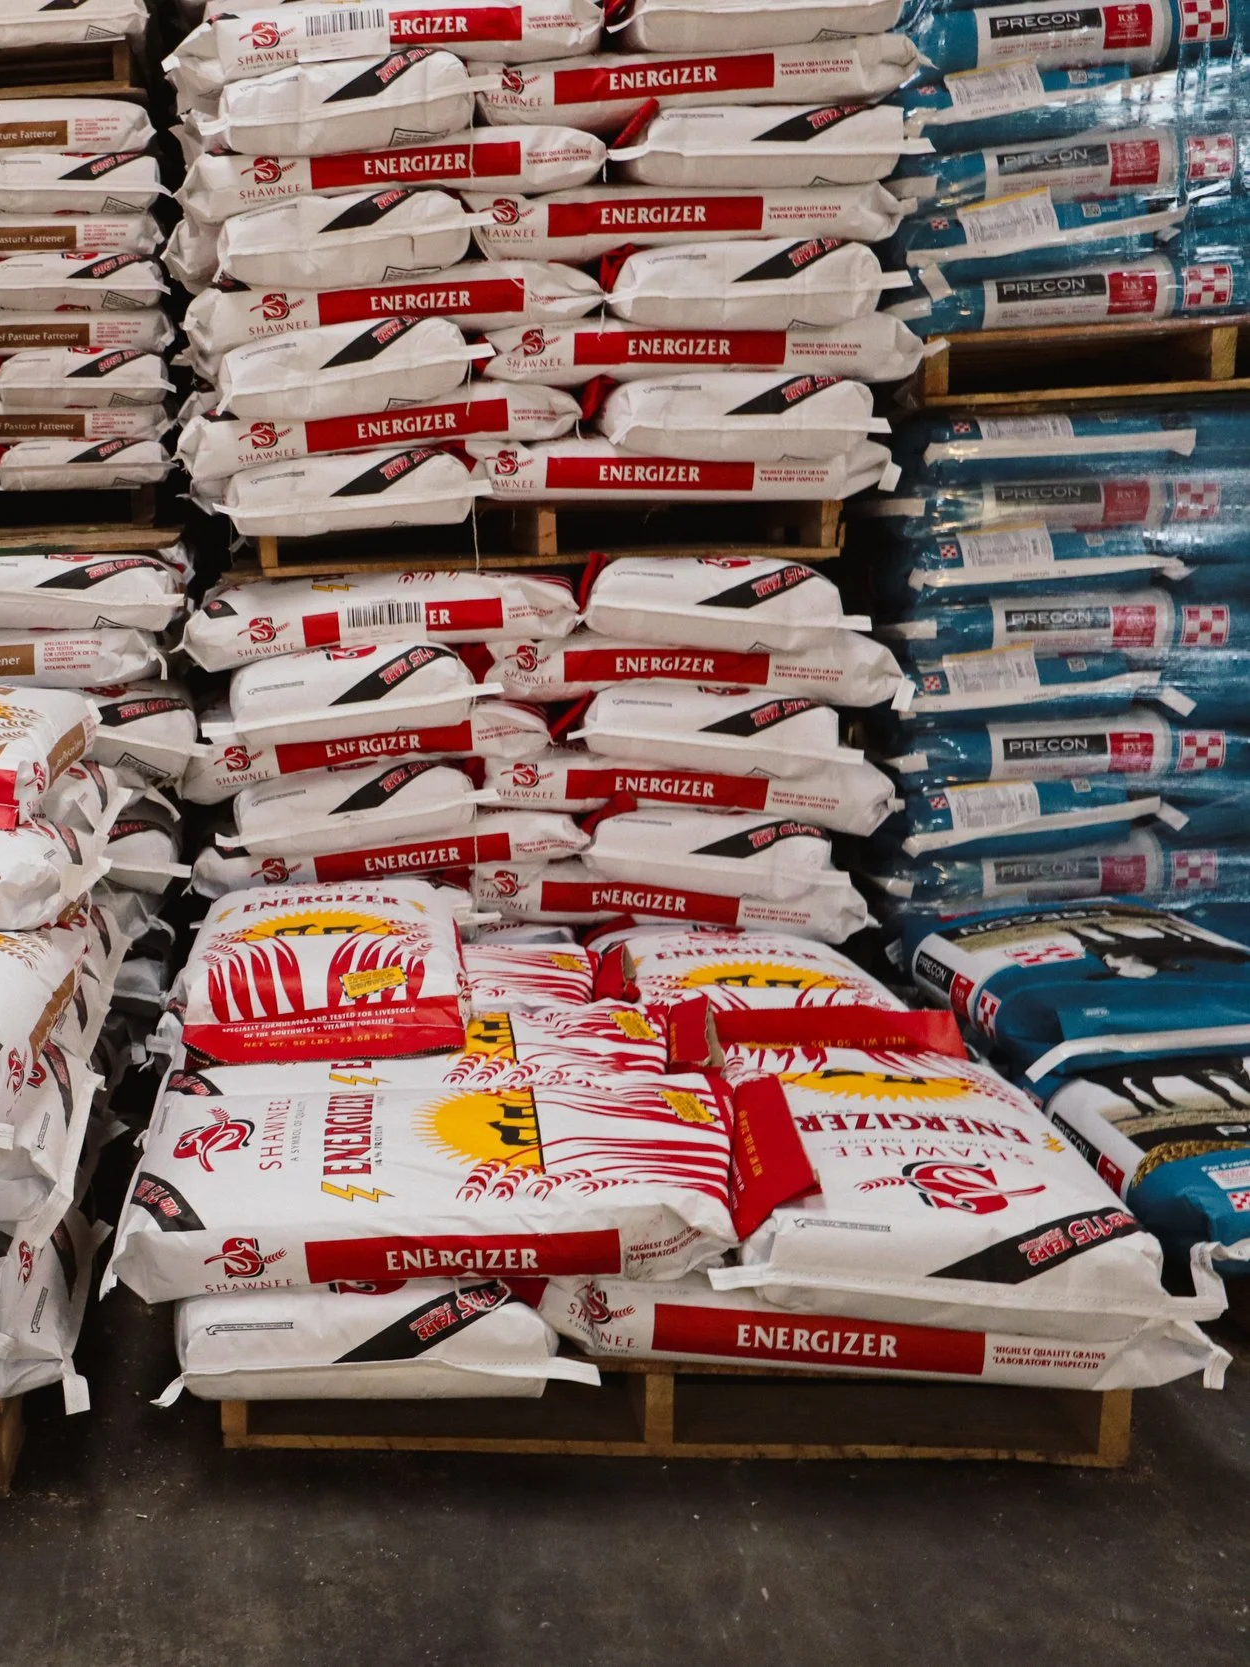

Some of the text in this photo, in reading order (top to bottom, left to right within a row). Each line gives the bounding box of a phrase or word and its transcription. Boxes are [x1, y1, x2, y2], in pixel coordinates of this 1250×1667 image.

[390, 16, 468, 35] ERGIZER
[996, 12, 1080, 30] PRECON
[237, 49, 298, 66] SHAWNEE
[609, 65, 717, 91] ENERGIZER
[20, 130, 57, 139] Fattener
[364, 153, 466, 175] ENERGIZER
[600, 205, 706, 225] ENERGIZER
[1002, 278, 1086, 296] PRECON
[370, 290, 471, 311] ENERGIZER
[8, 332, 41, 341] Pasture
[43, 332, 79, 340] Fattener
[248, 320, 309, 335] SHAWNEE
[628, 338, 730, 356] ENERGIZER
[357, 412, 457, 439] ENERGIZER
[1001, 486, 1081, 500] PRECON
[616, 657, 714, 673] ENERGIZER
[1009, 738, 1088, 753] PRECON
[615, 776, 714, 798] ENERGIZER
[364, 847, 460, 871] ENERGIZER
[243, 894, 398, 913] ENERGIZER
[592, 889, 686, 912] ENERGIZER
[918, 956, 947, 982] PRECON
[259, 1099, 291, 1171] SHAWNEE
[794, 1112, 1032, 1145] ENERGIZER
[834, 1144, 1035, 1166] SHAWNEE
[386, 1248, 538, 1270] ENERGIZER
[737, 1324, 897, 1358] ENERGIZER
